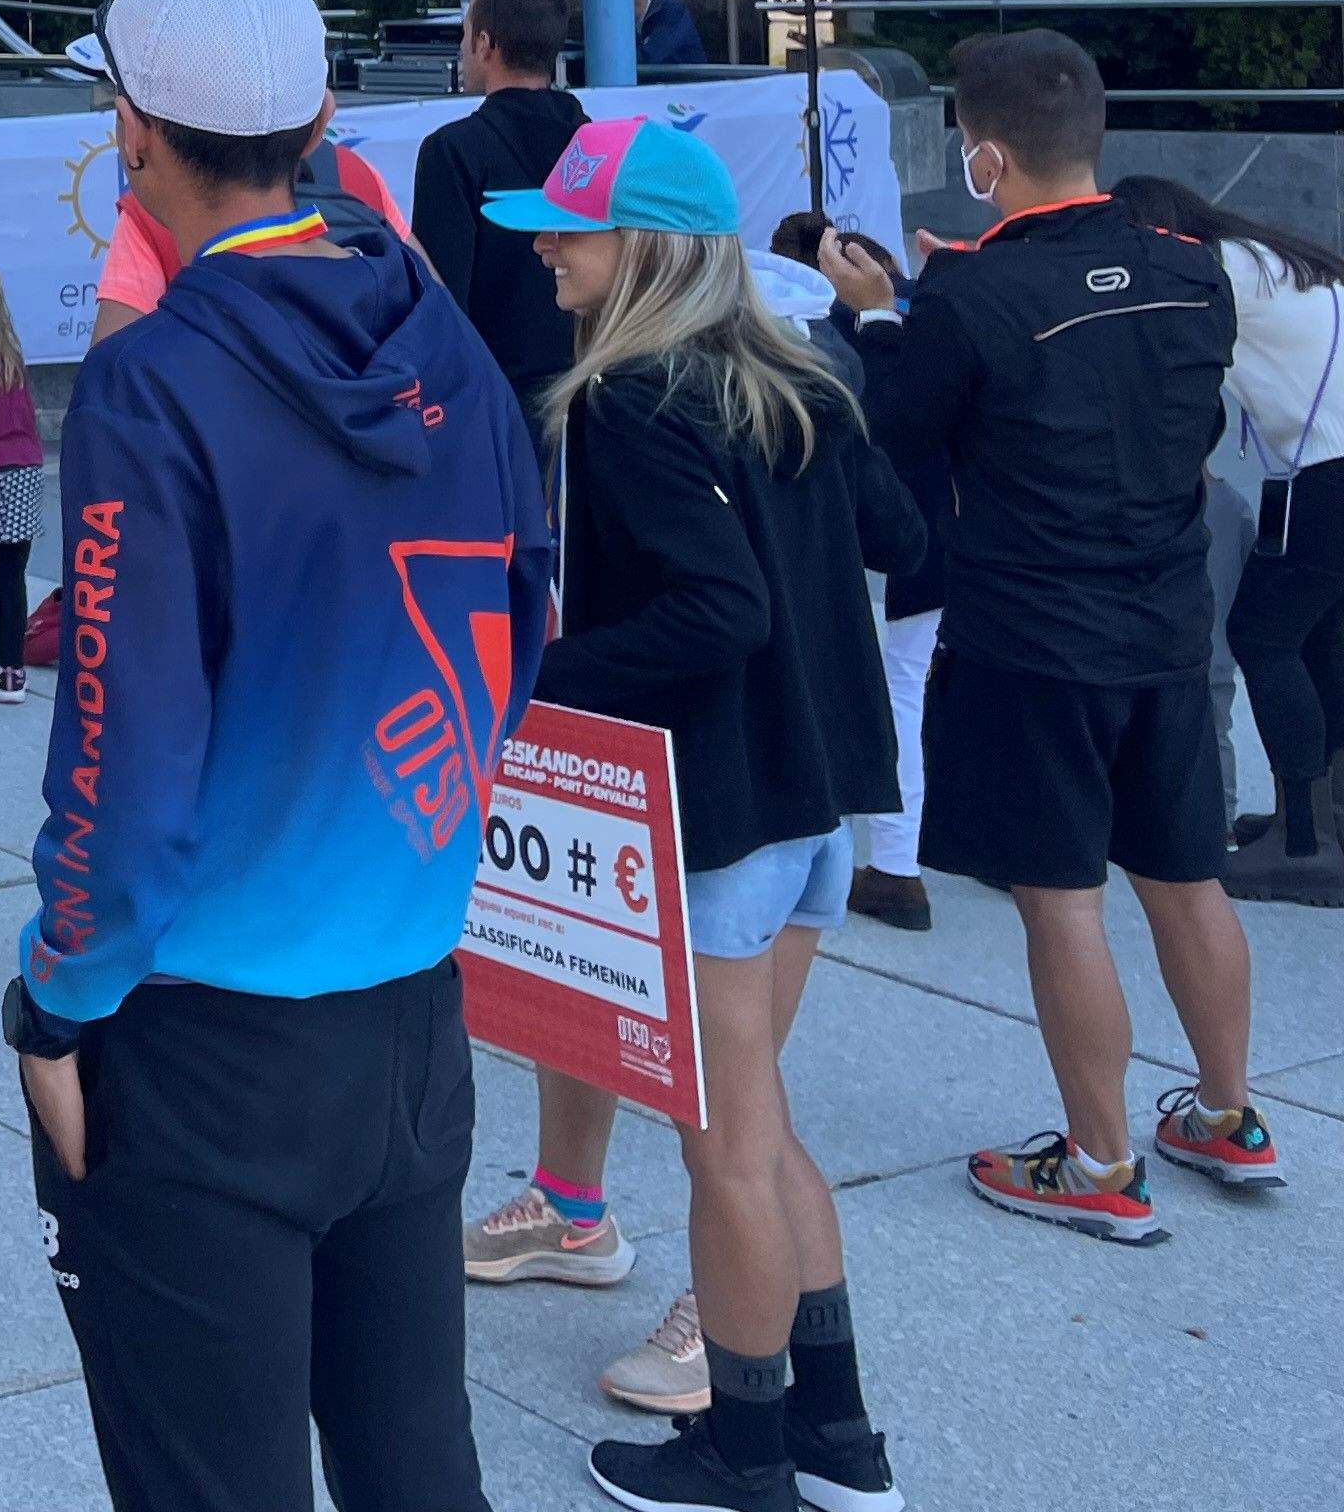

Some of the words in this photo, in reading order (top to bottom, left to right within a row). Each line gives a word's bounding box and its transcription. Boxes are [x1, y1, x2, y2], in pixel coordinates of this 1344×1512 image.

[71, 499, 125, 807] ANDORRA
[375, 688, 470, 850] OTSO
[501, 738, 647, 795] 25KANDORRA
[503, 763, 547, 784] ENCAMP
[554, 776, 582, 795] PORT
[56, 812, 95, 875] IN
[484, 814, 551, 882] 00
[567, 838, 598, 898] #
[614, 844, 649, 914] €
[463, 918, 566, 969] CLASSIFICADA
[568, 954, 650, 999] FEMENINA
